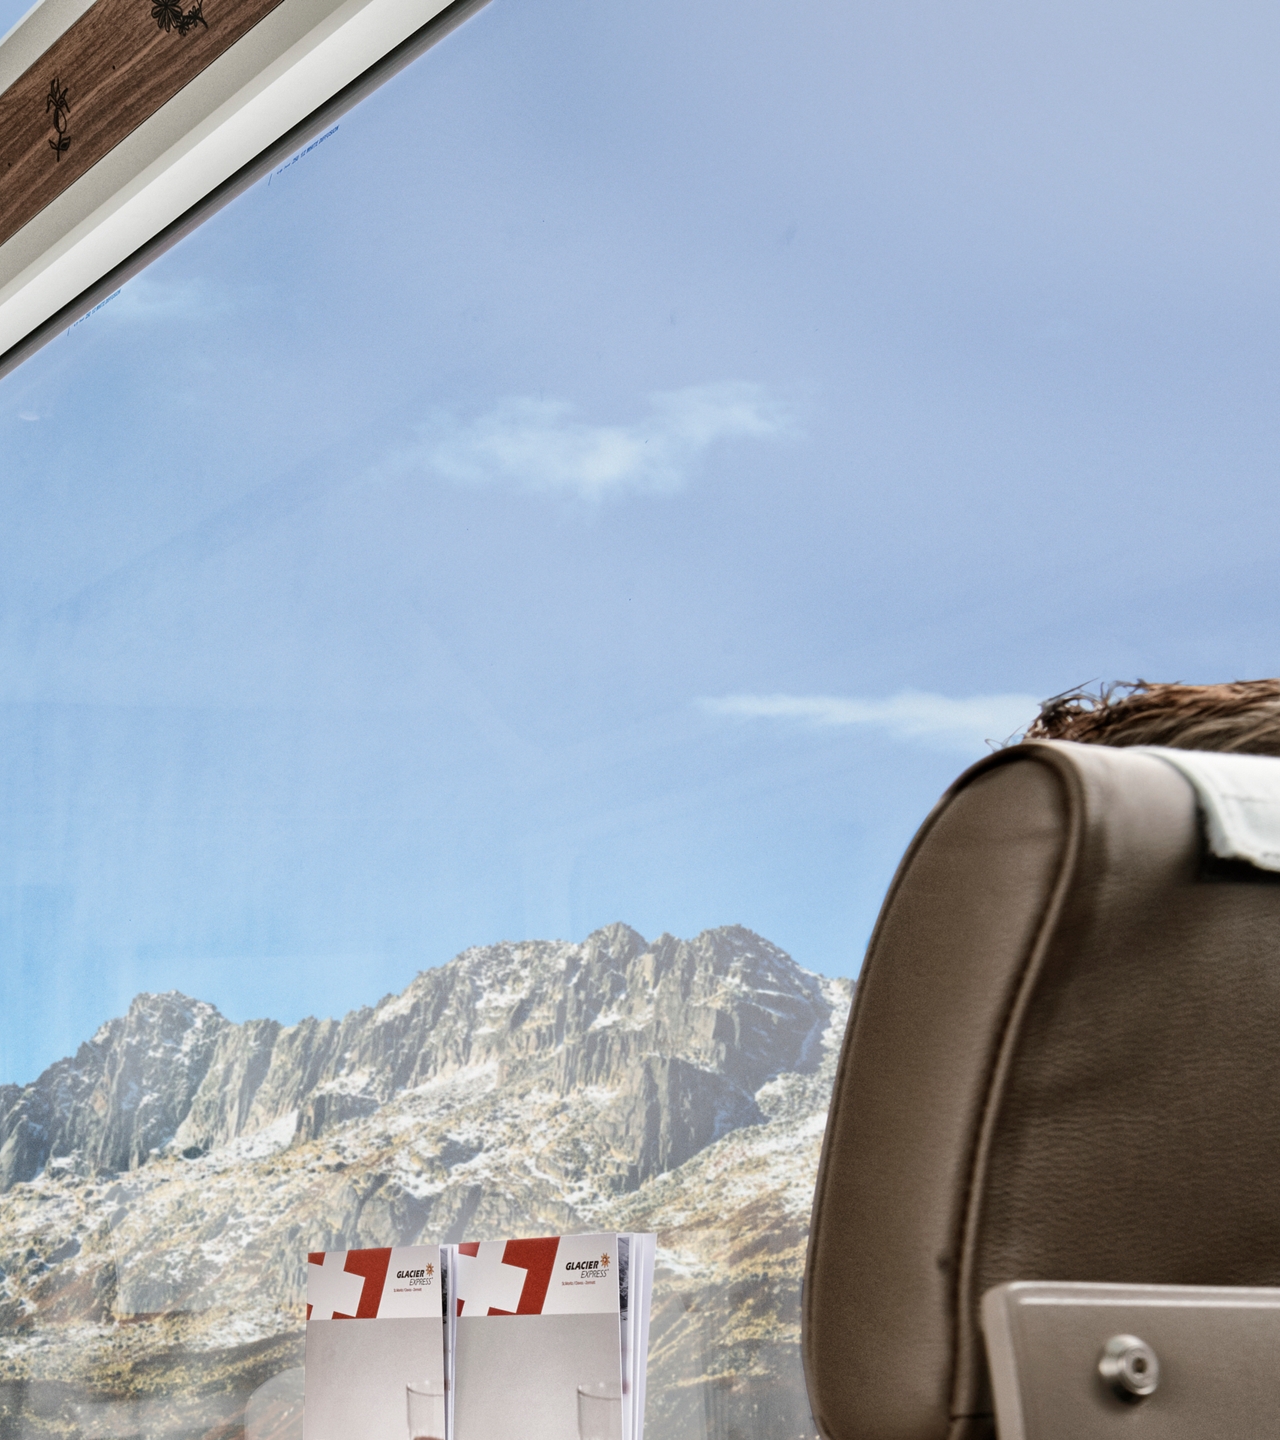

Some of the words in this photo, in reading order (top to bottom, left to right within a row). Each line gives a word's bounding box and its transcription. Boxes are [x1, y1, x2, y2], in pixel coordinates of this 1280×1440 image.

[565, 1260, 599, 1271] GLACIER
[396, 1270, 425, 1279] GLACIER
[580, 1270, 607, 1278] EXPRESS
[409, 1278, 432, 1286] EXPRESS
